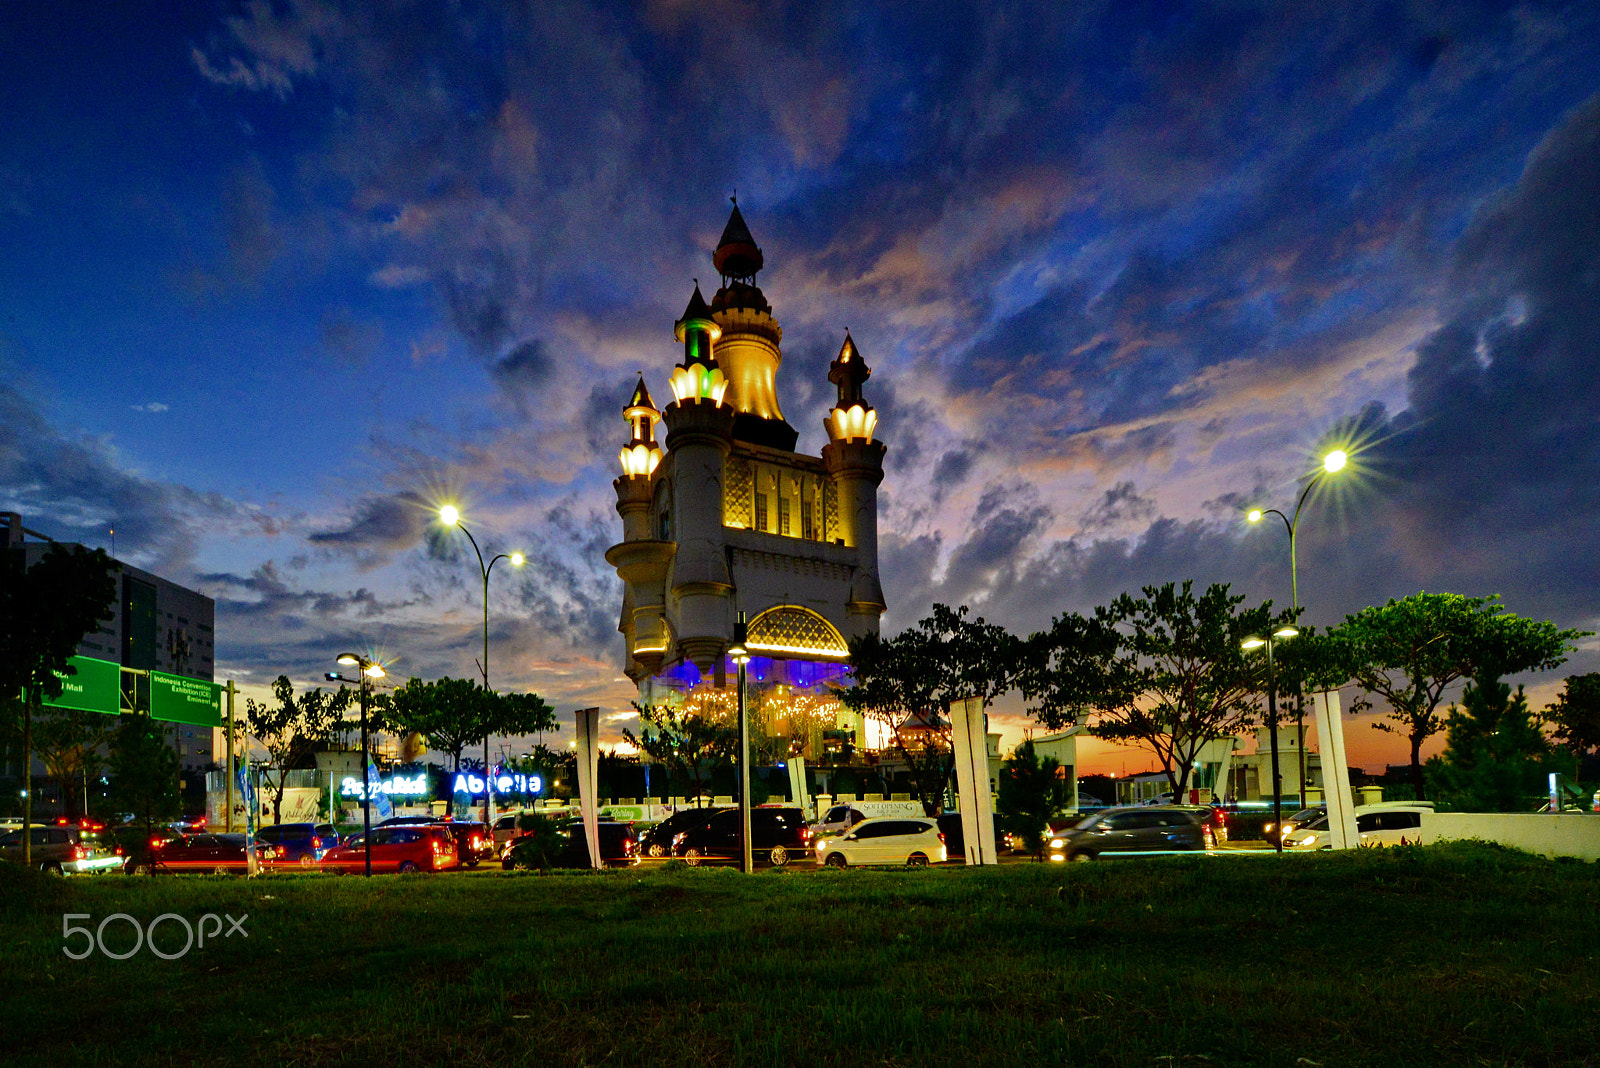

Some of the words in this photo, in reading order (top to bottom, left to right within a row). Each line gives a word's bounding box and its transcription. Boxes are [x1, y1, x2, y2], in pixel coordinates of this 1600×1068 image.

[66, 682, 83, 693] Mall
[154, 675, 181, 686] Indonesia
[182, 680, 212, 692] Convention
[172, 685, 199, 696] Exhibition
[187, 695, 211, 705] Eminent
[881, 803, 913, 811] OPENING
